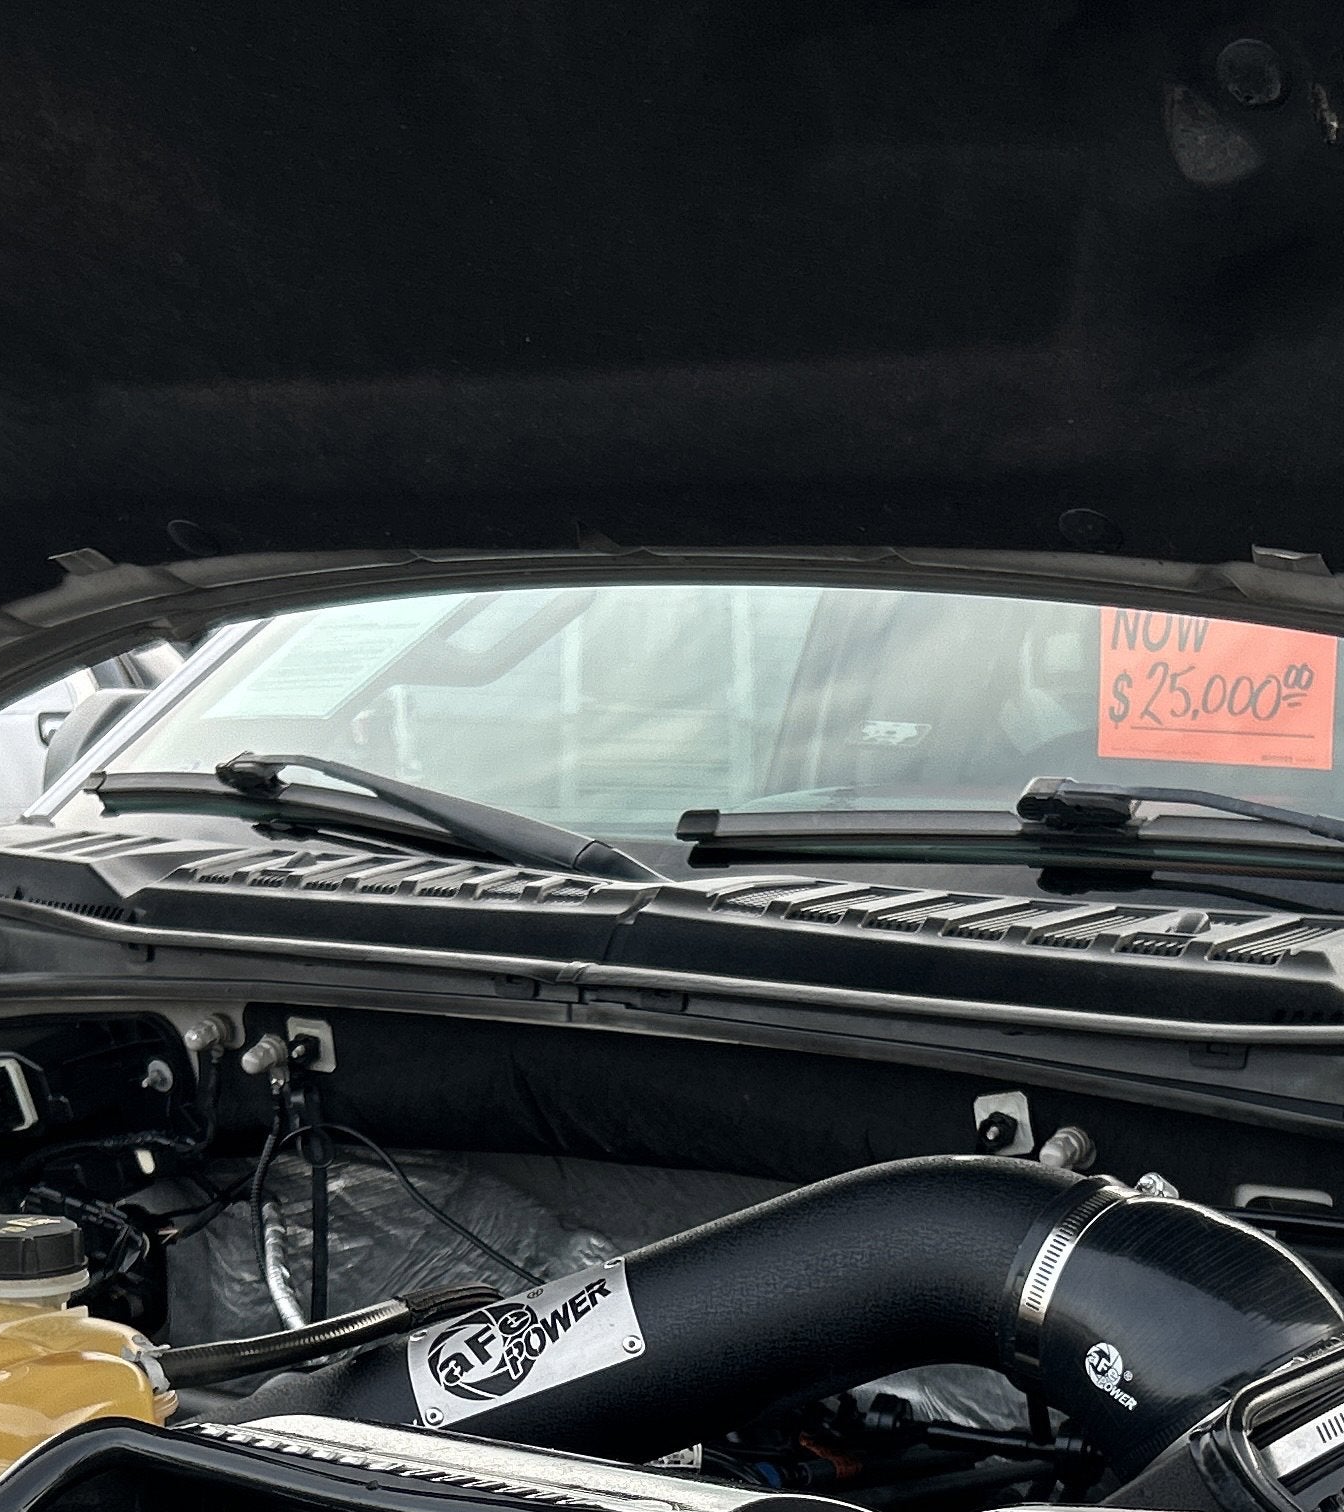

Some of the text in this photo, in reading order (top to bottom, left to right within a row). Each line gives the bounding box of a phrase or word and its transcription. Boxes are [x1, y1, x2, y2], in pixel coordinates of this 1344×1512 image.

[1110, 609, 1210, 653] NOW
[504, 1277, 612, 1380] POWER
[1097, 1376, 1138, 1411] POWER
